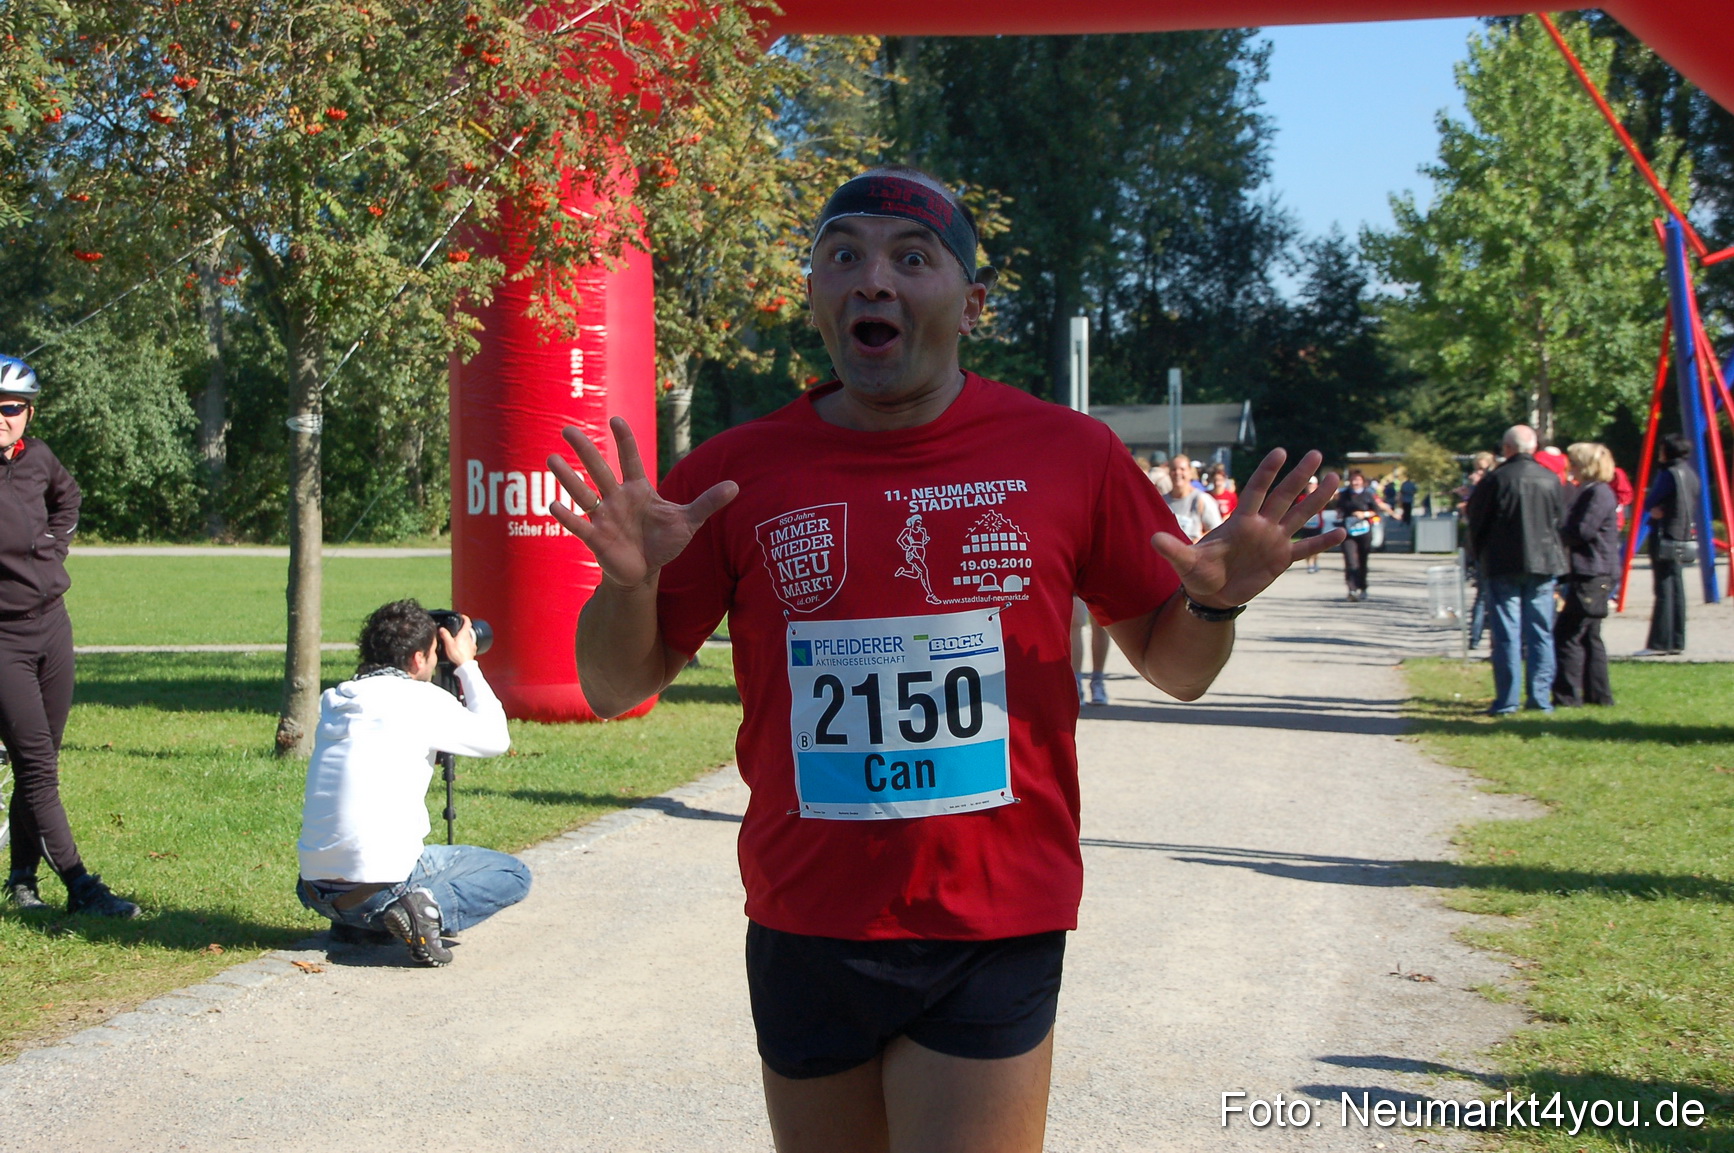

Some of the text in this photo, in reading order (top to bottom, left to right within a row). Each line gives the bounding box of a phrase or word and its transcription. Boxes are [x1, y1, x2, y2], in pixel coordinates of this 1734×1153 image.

[884, 479, 1028, 502] 11. NEUMARKTER
[908, 492, 1007, 513] STADTLAUF
[507, 520, 544, 536] Sicher
[779, 511, 816, 526] 850 Jahre
[769, 518, 831, 546] IMMER
[770, 533, 835, 561] WIEDER
[777, 550, 831, 583] NEU
[960, 558, 1032, 572] 19.09.2010
[782, 575, 833, 599] MARKT
[943, 593, 1030, 605] www.stadtlauf-neumarkt.de
[813, 636, 905, 656] PFLEIDERER
[929, 632, 984, 652] BOCK
[815, 655, 906, 667] AKTIENGESELLSCHAFT
[812, 665, 984, 745] 2150
[801, 735, 809, 748] B
[864, 753, 936, 793] Can
